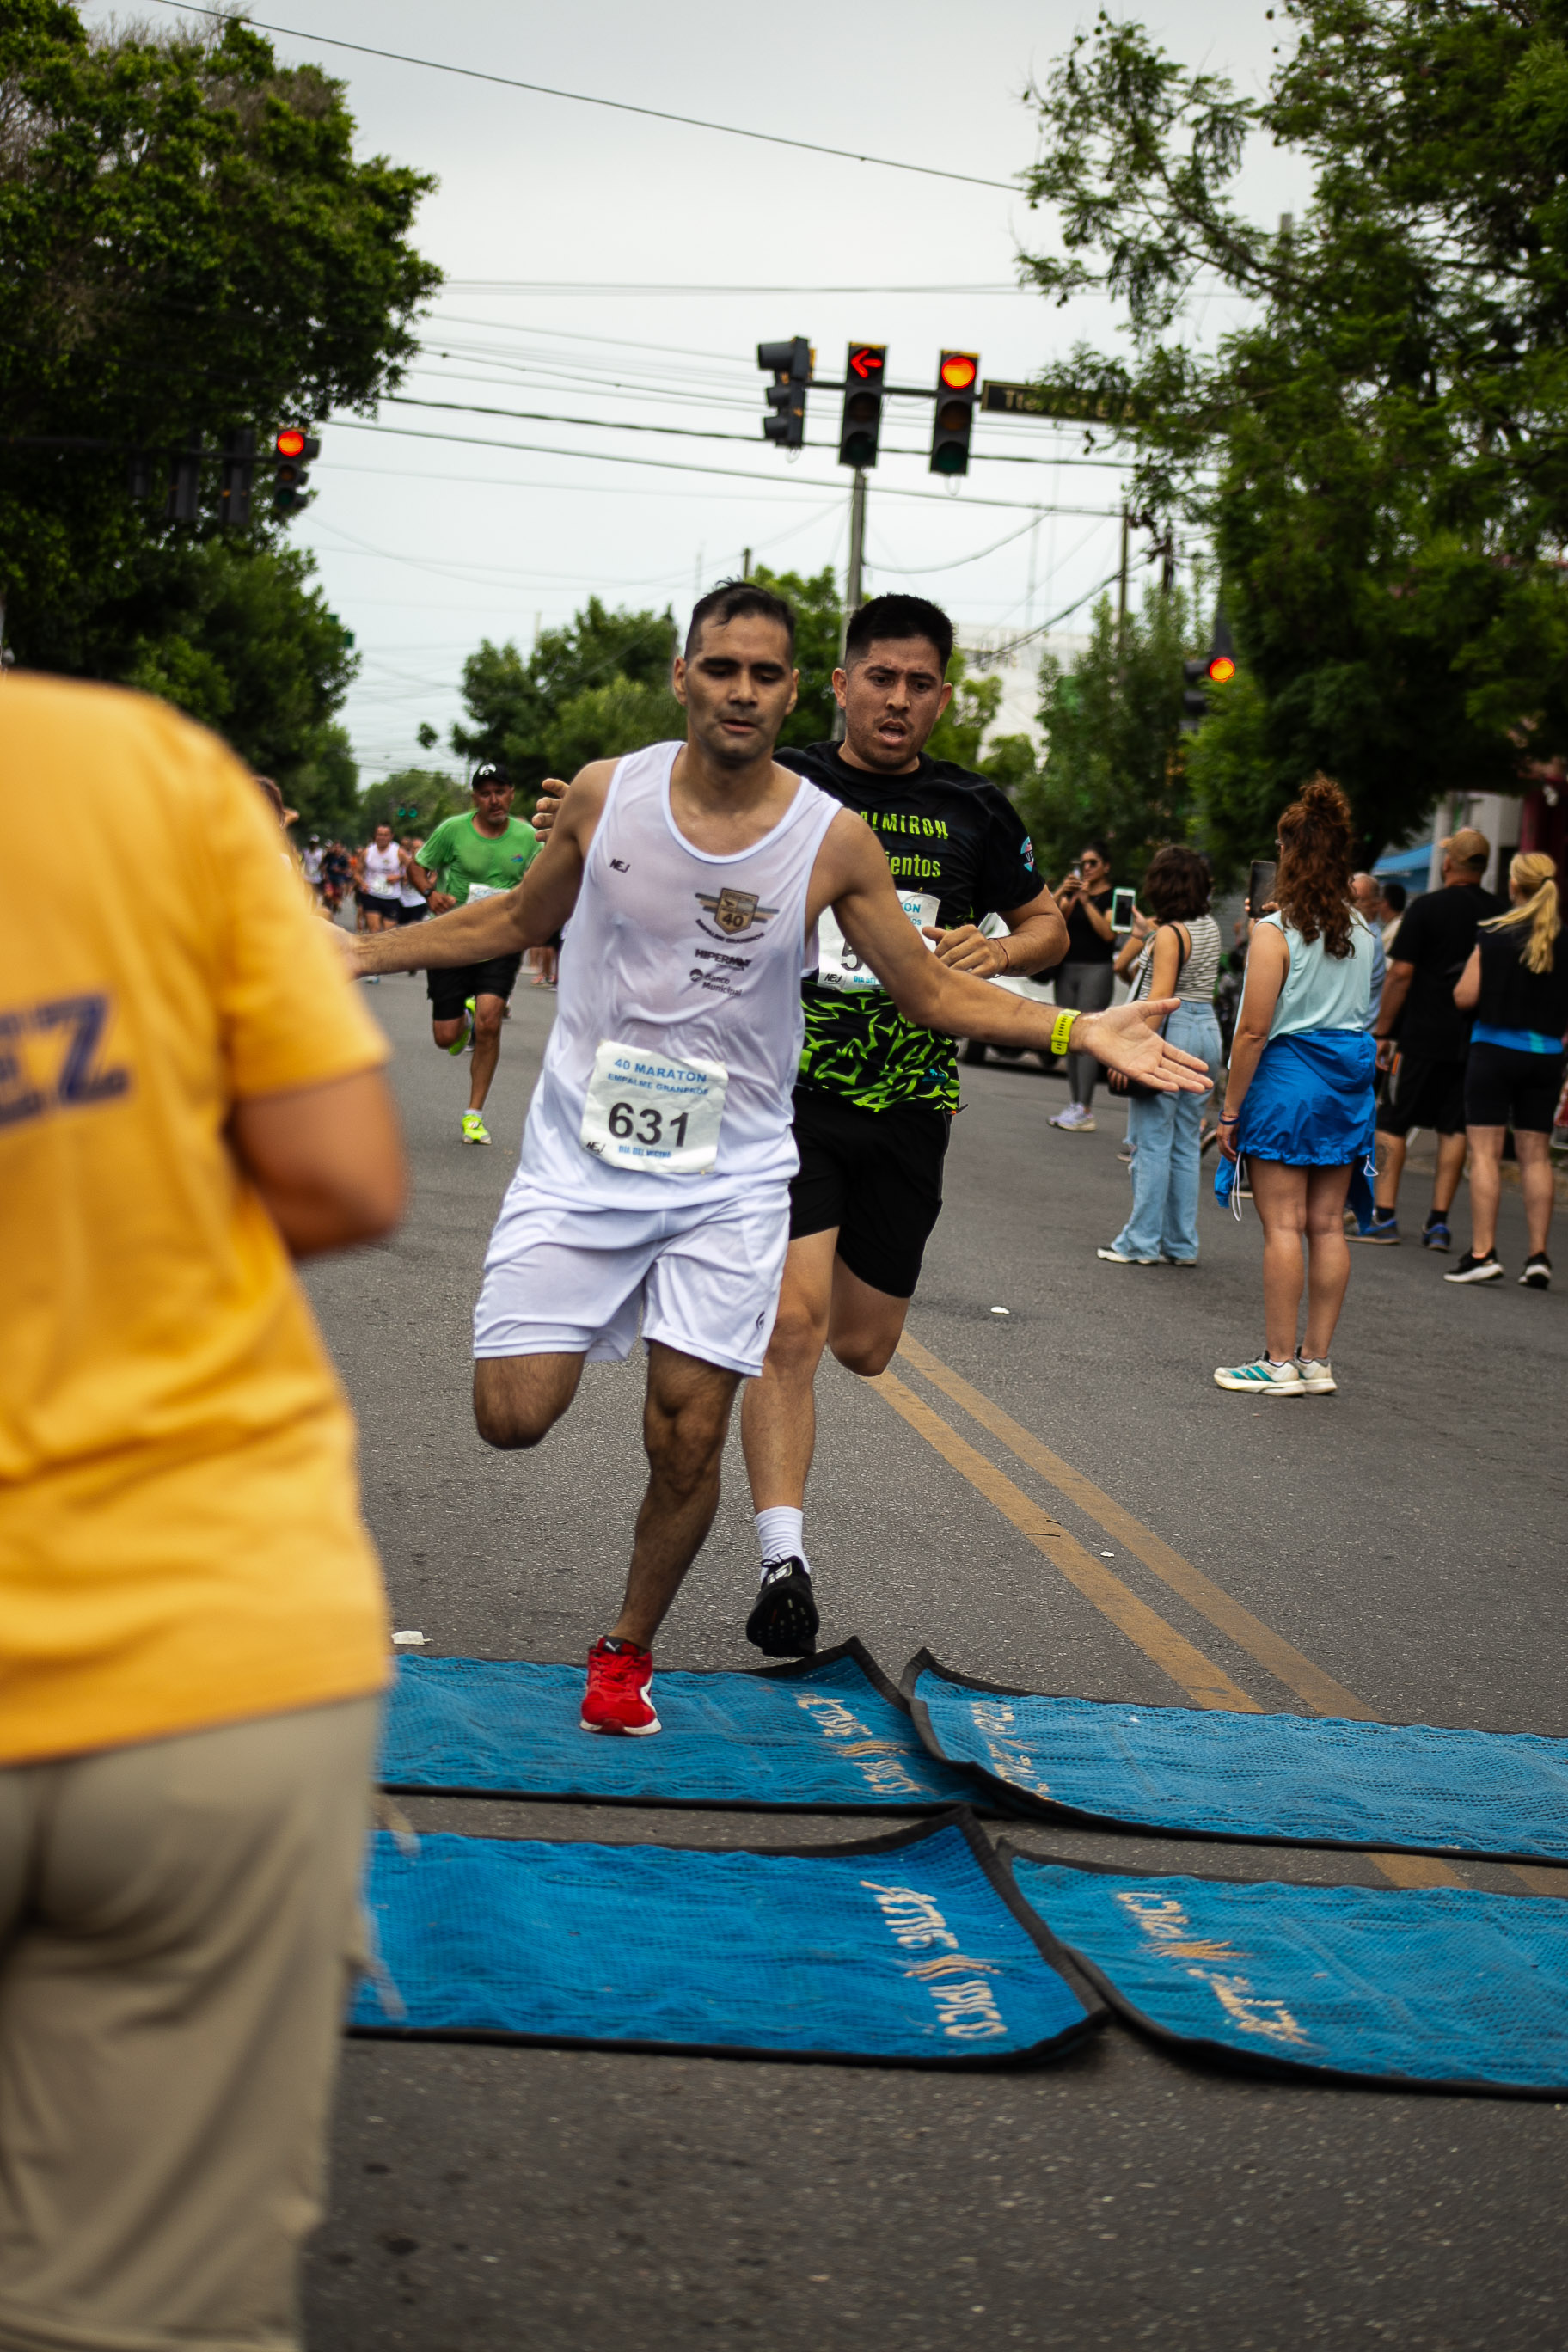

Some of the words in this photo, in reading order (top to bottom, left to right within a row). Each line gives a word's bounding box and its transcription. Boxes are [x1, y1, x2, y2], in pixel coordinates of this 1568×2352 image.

[901, 903, 922, 914] ON
[722, 913, 744, 928] 40
[824, 973, 843, 985] NEJ
[701, 982, 743, 997] Municipal
[614, 1058, 631, 1071] 40
[634, 1063, 707, 1084] MARATON
[608, 1073, 652, 1089] EMPALME
[609, 1102, 689, 1148] 631
[928, 1980, 1008, 2039] IPICO
